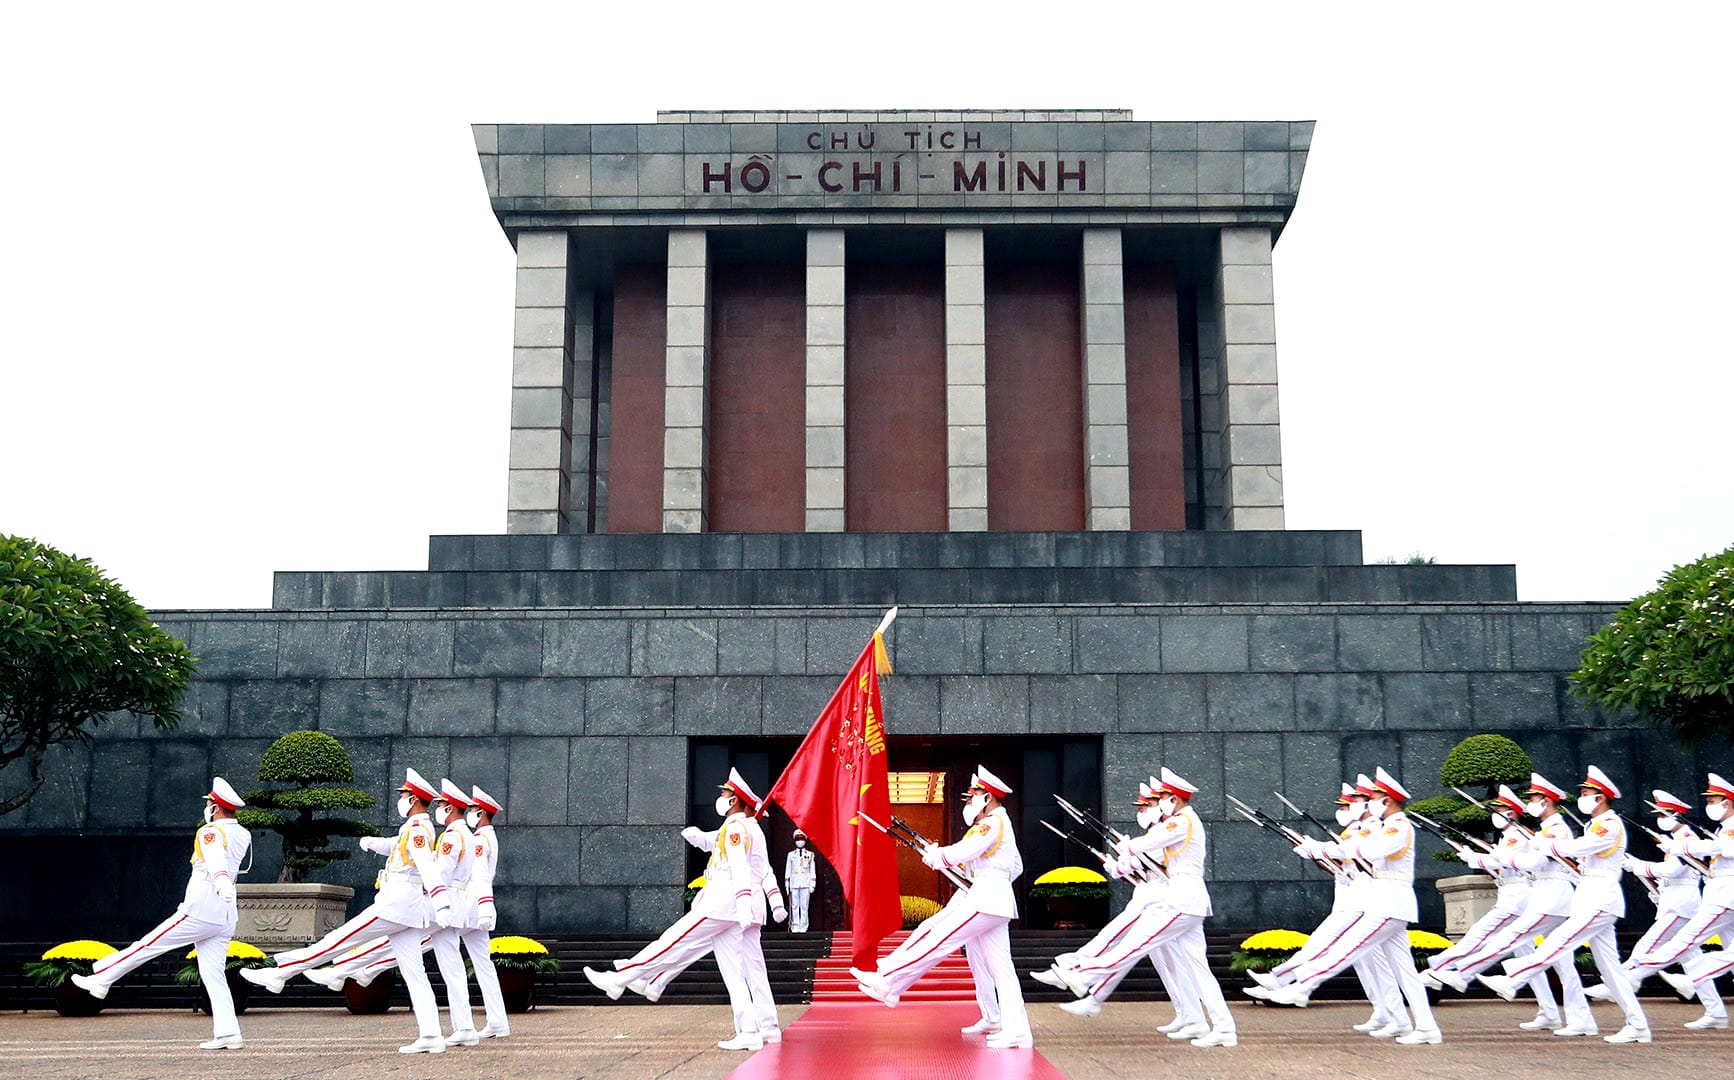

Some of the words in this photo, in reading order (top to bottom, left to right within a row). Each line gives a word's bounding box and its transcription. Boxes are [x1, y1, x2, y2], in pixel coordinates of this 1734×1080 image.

[807, 124, 875, 150] CHỦ
[904, 125, 981, 157] TỊCH
[703, 154, 774, 193] HỒ
[817, 153, 906, 193] CHÍ
